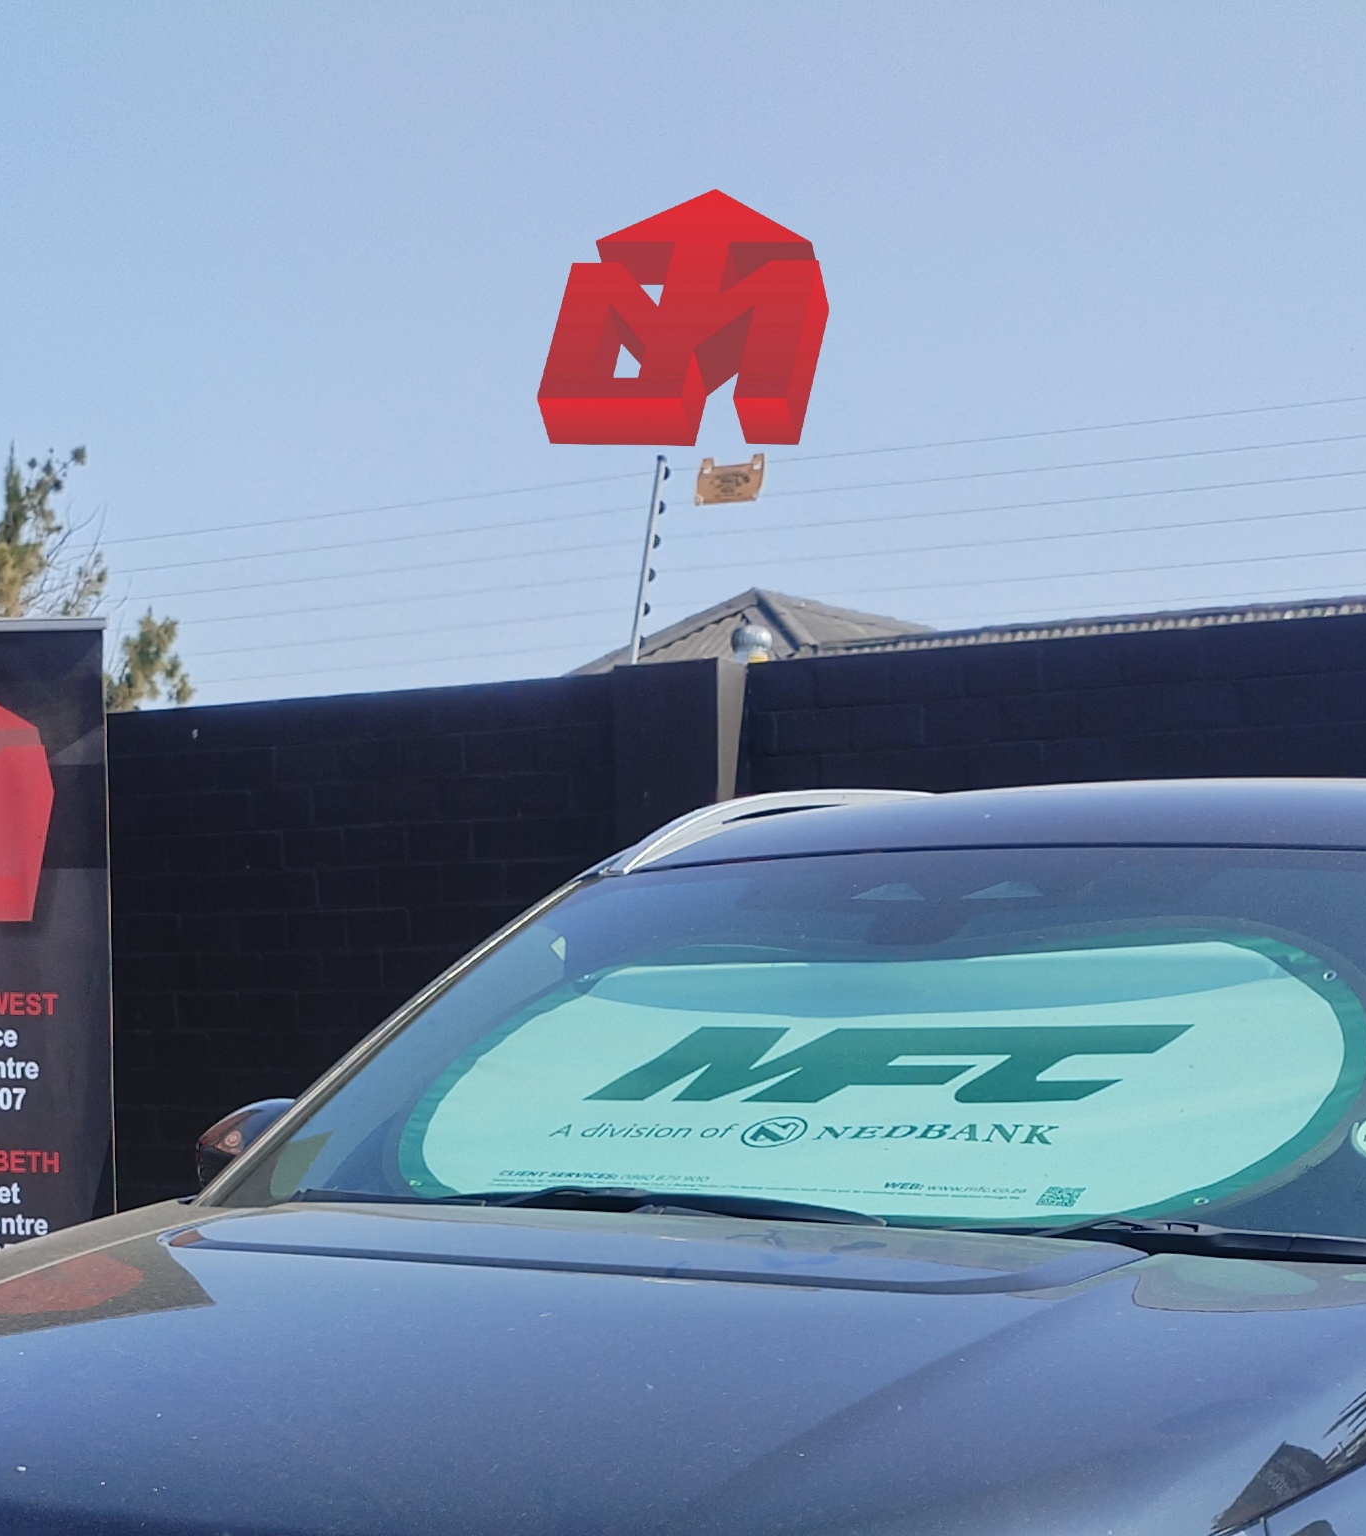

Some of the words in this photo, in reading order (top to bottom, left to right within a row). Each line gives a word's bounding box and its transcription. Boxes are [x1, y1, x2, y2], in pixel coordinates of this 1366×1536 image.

[582, 1023, 1195, 1104] MFC
[549, 1123, 572, 1138] A
[580, 1122, 693, 1139] division
[699, 1123, 740, 1139] of
[813, 1124, 1060, 1147] NEDBANK
[498, 1169, 549, 1178] CLIENT
[548, 1171, 619, 1181] SERVICES:
[883, 1181, 926, 1191] WEB:
